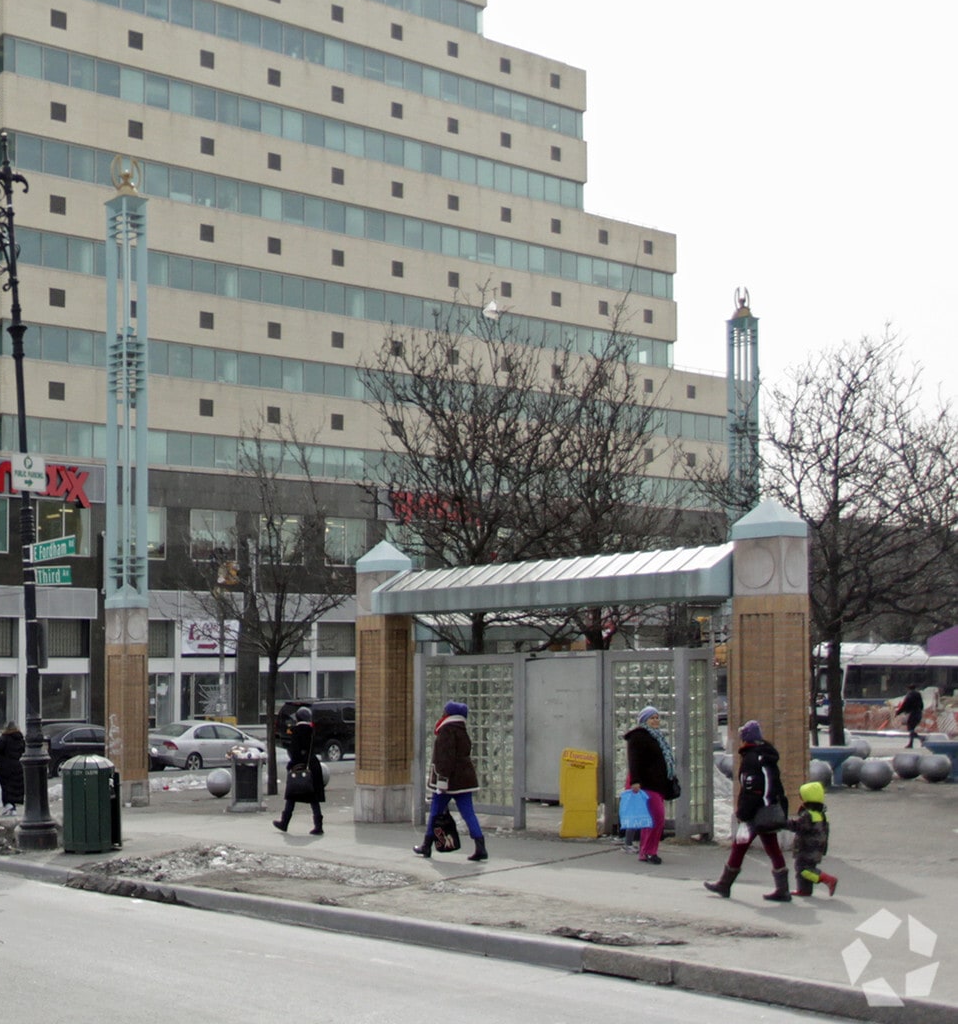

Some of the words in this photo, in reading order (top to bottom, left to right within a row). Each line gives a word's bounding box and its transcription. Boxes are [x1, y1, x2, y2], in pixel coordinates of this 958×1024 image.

[14, 469, 27, 477] PUBLIC
[28, 471, 44, 479] PARKING
[39, 542, 67, 560] Fordham
[38, 569, 61, 583] Third
